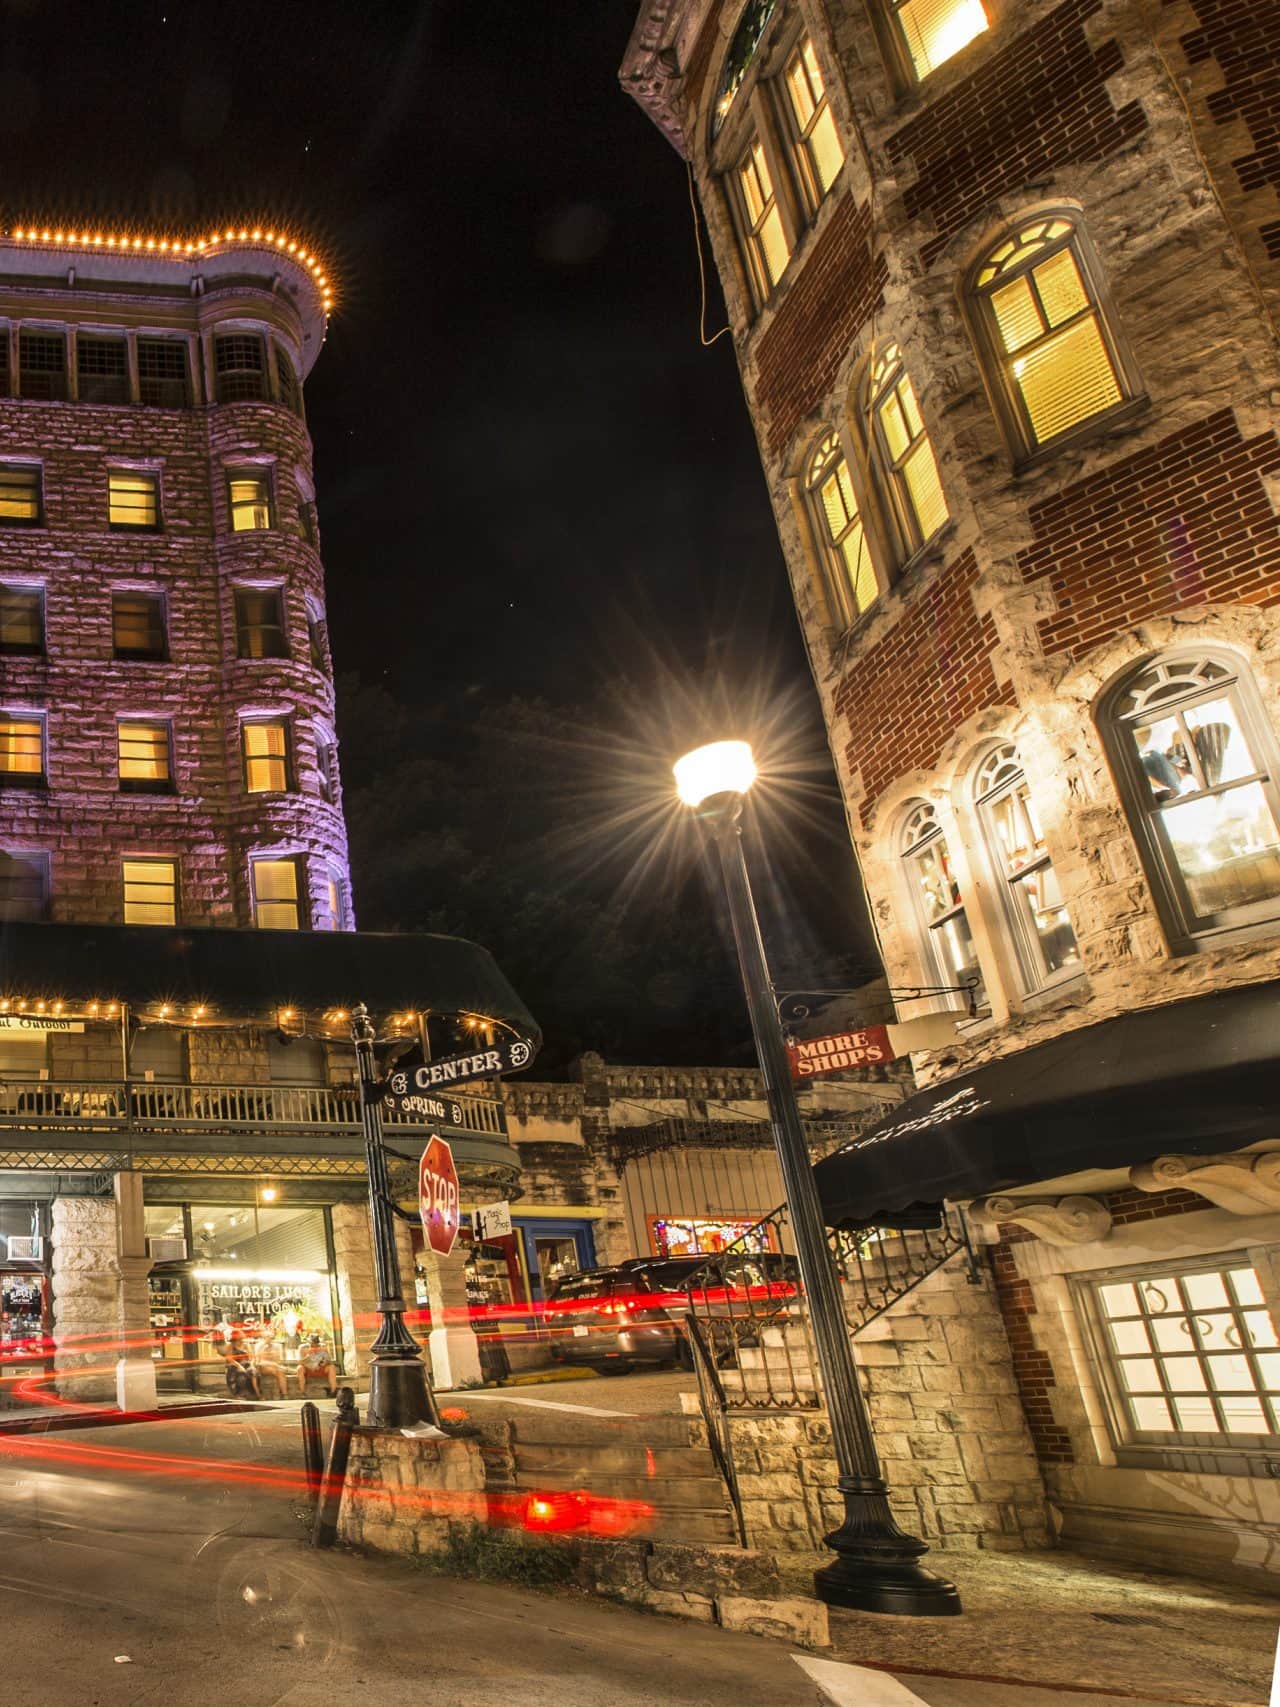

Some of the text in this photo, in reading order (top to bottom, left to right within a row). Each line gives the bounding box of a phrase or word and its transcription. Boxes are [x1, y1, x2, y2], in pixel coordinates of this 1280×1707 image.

[797, 1032, 869, 1059] MORE
[415, 1051, 503, 1088] CENTER
[797, 1045, 883, 1075] SHOPS
[401, 1096, 445, 1118] SPRING
[422, 1168, 456, 1216] STOP
[211, 1286, 272, 1298] SAILOR'S
